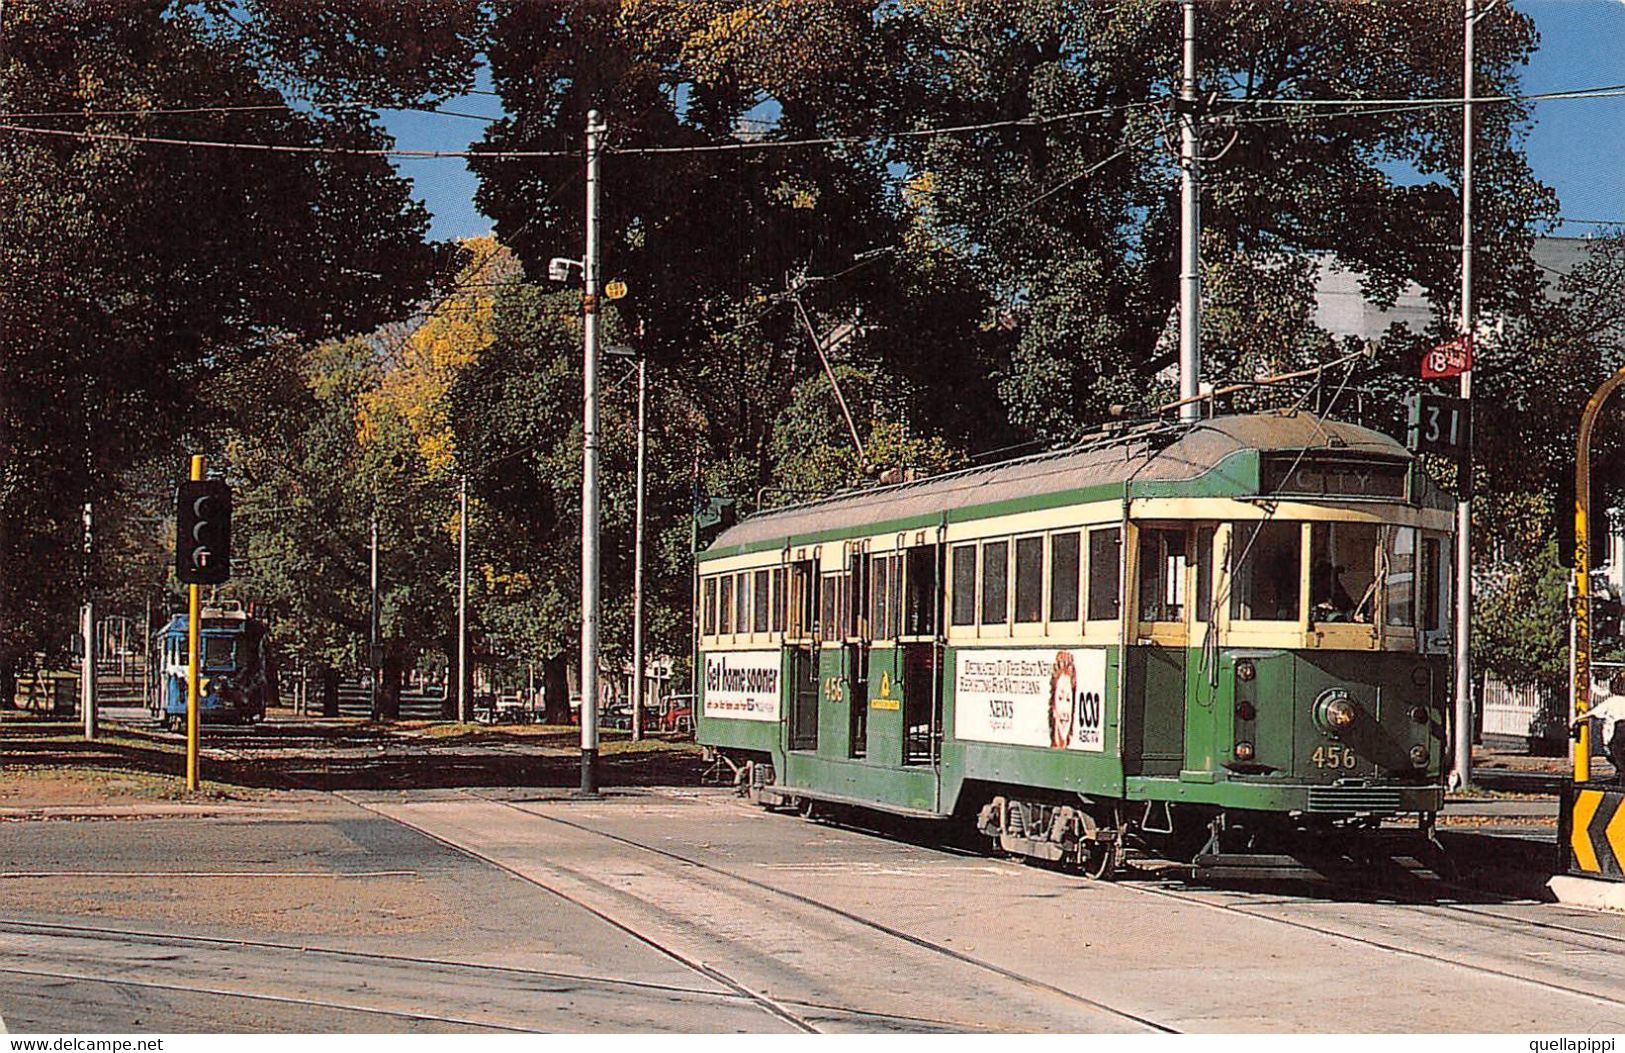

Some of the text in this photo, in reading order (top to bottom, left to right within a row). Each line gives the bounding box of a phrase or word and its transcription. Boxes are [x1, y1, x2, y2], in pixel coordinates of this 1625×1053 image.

[1296, 467, 1371, 493] CITY
[707, 656, 778, 693] Get home sooner
[989, 699, 1014, 719] NEWS
[1312, 746, 1356, 769] 456
